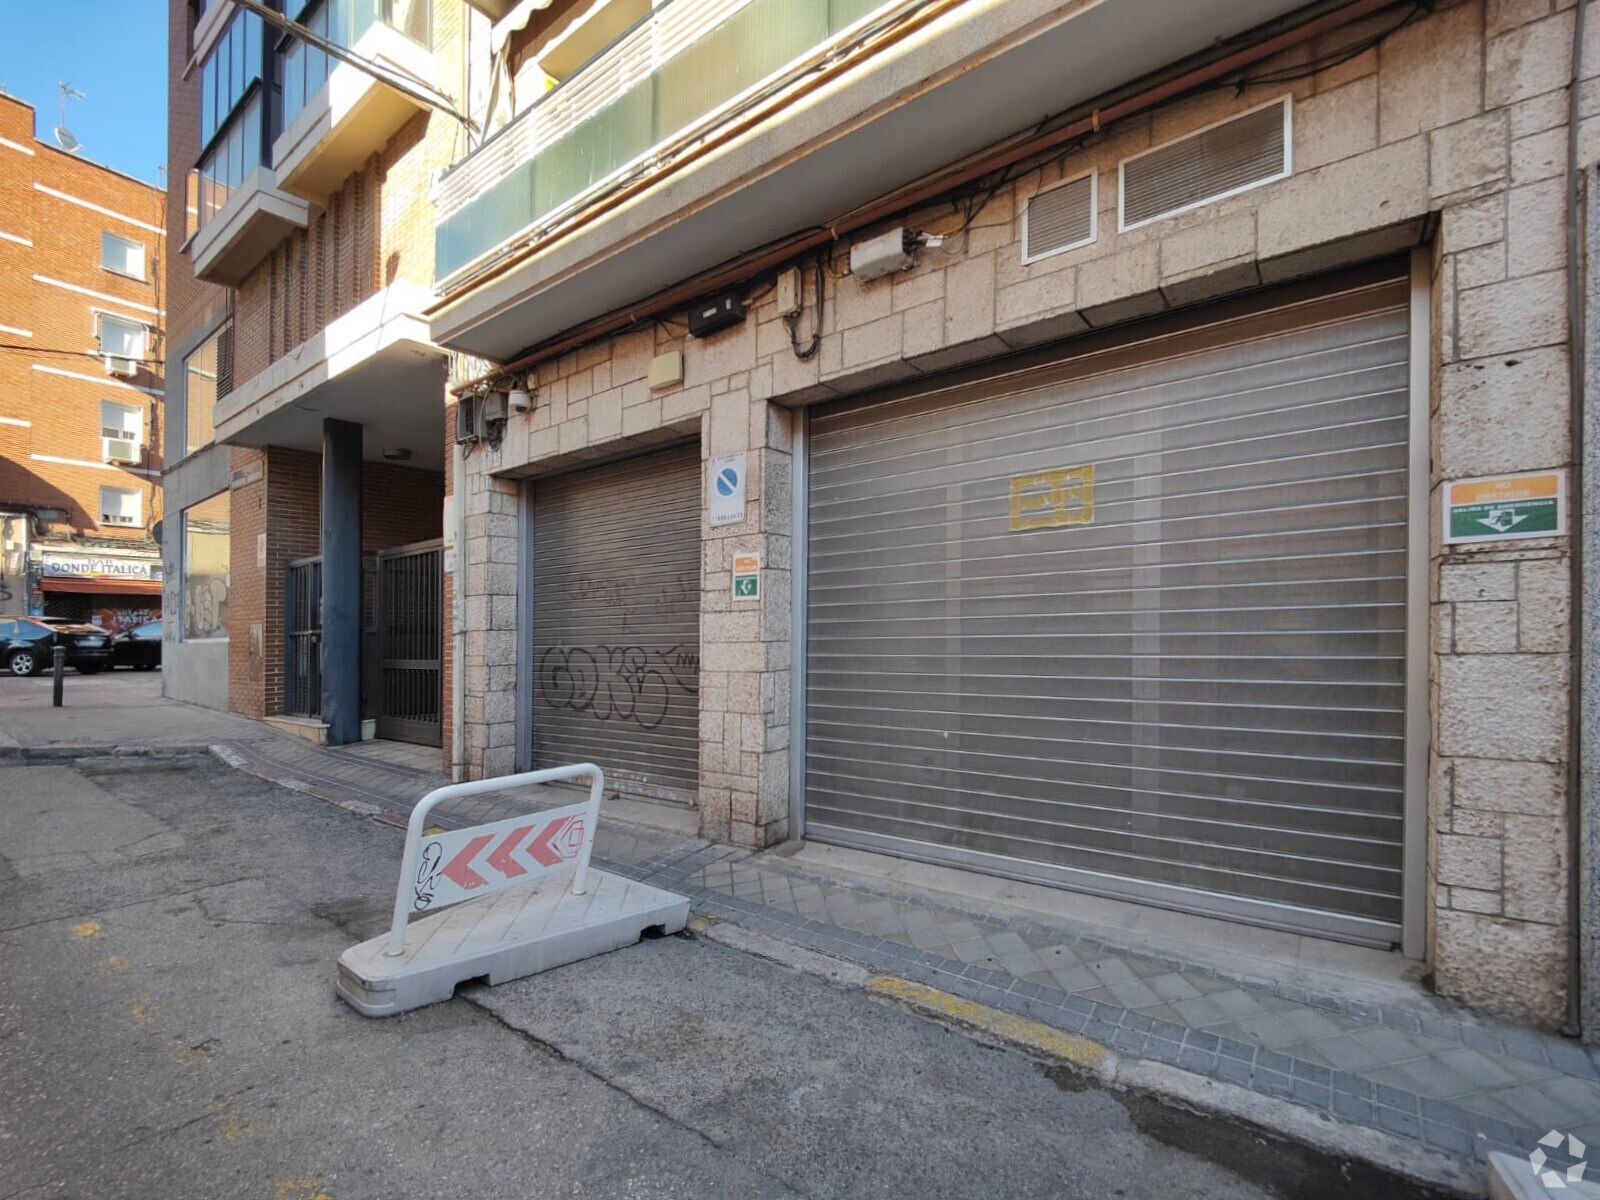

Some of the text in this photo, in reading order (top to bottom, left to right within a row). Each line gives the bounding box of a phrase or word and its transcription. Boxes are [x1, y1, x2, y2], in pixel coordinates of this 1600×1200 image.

[1497, 500, 1554, 510] EMERGENCIA
[52, 562, 148, 575] DONDE ITALICA
